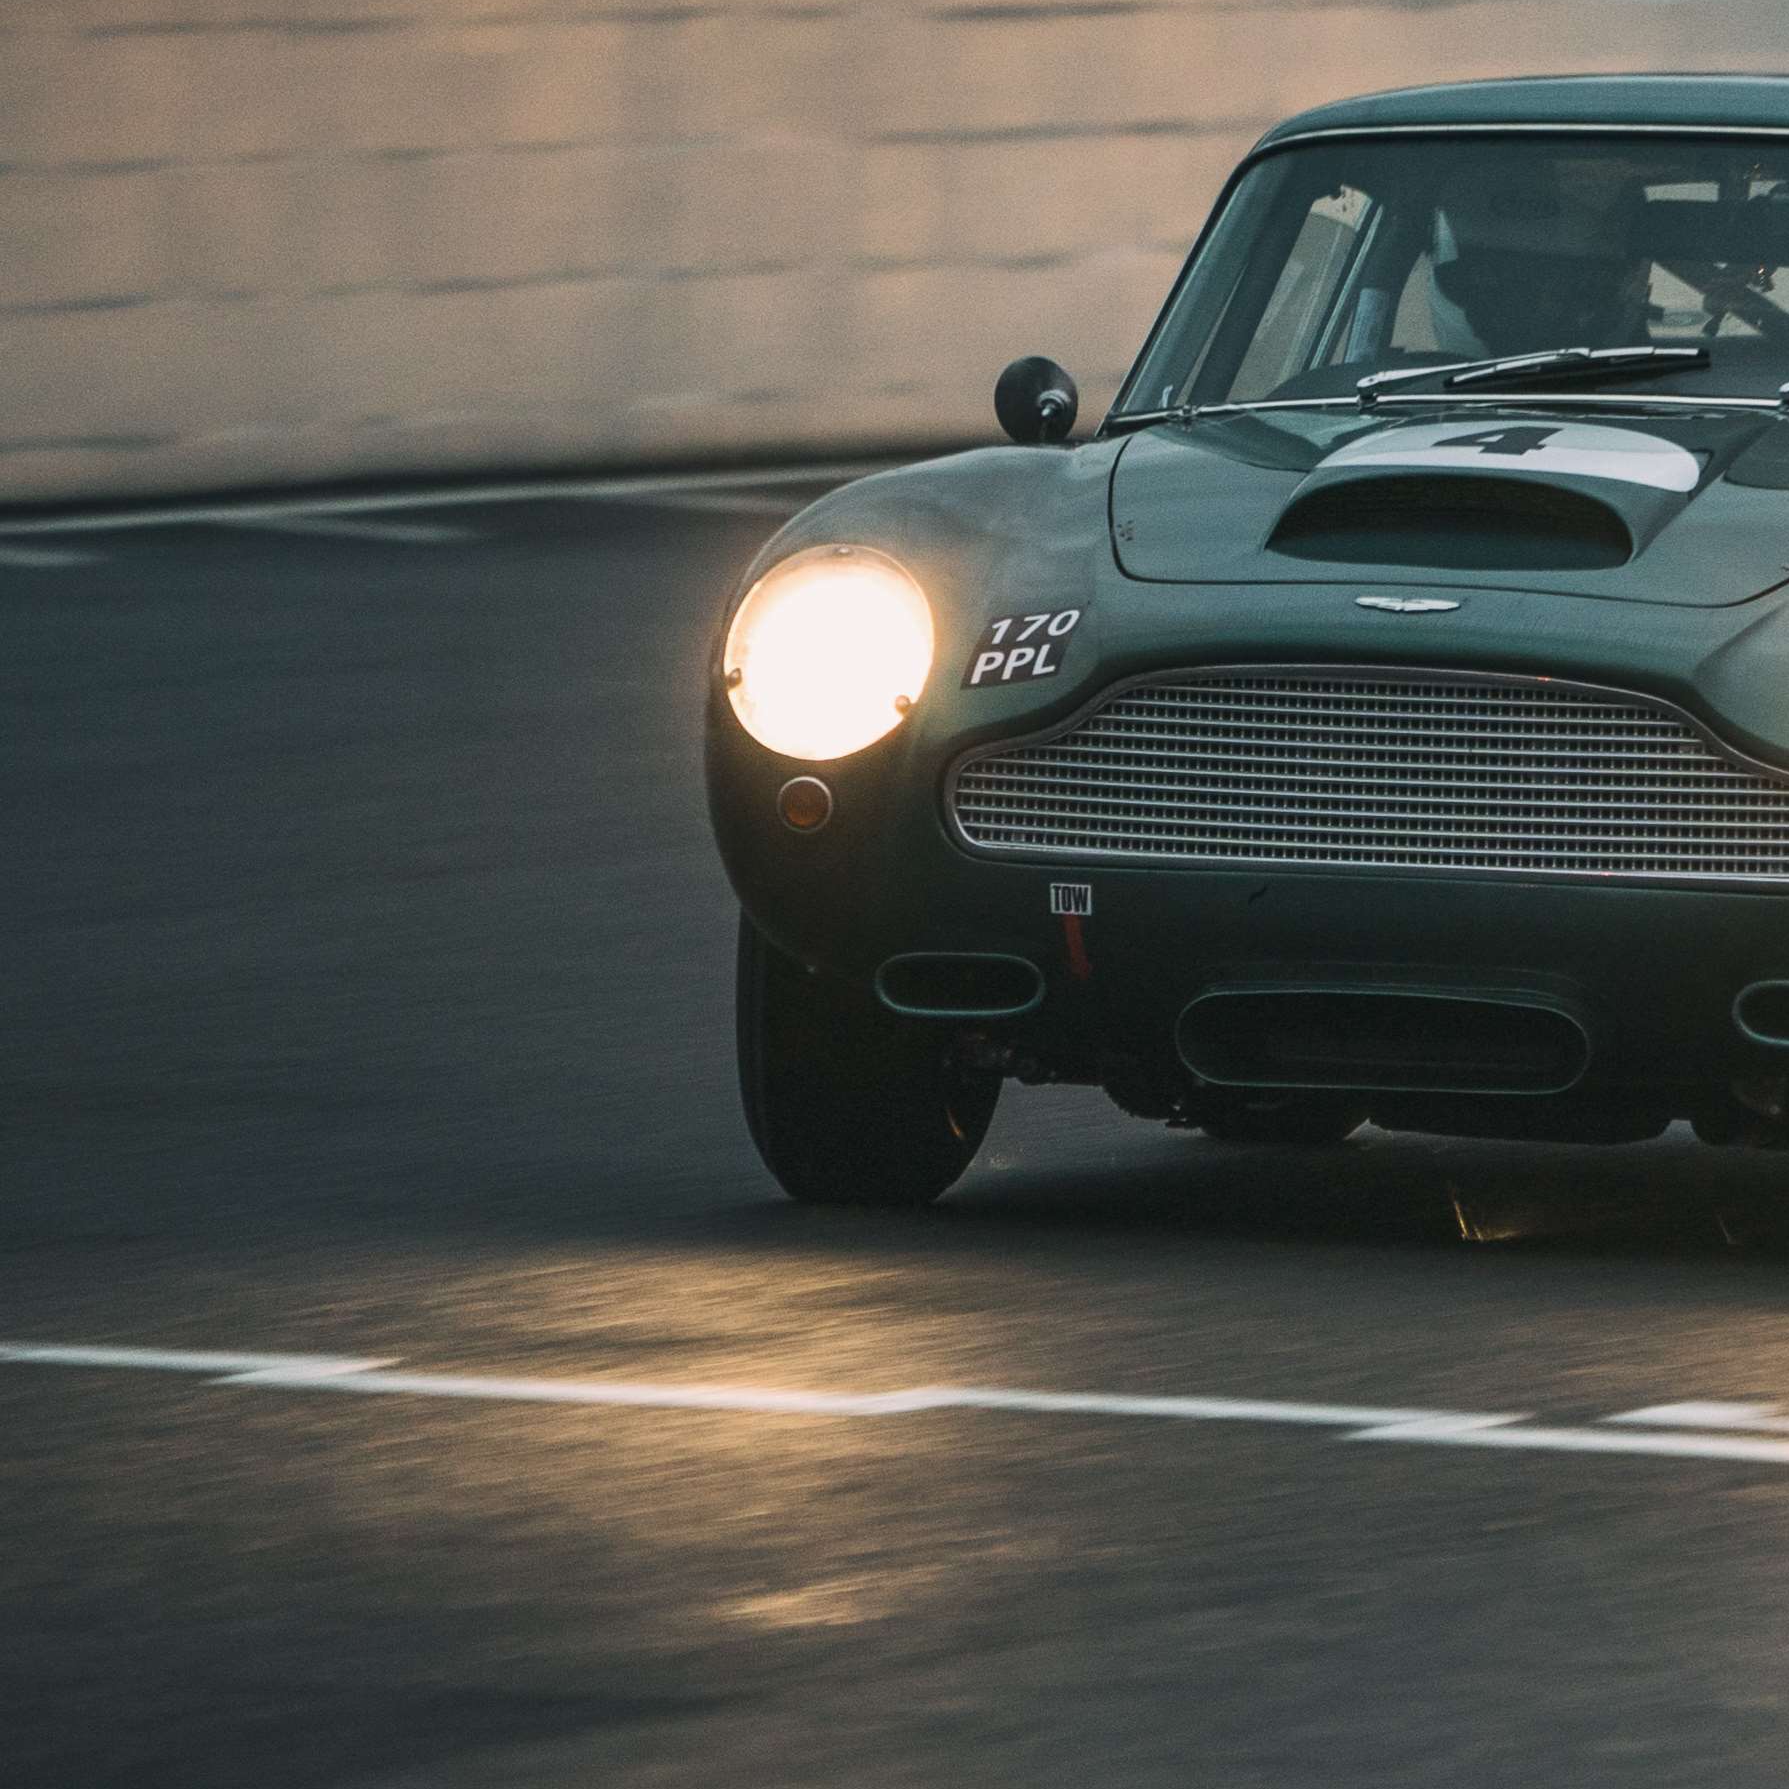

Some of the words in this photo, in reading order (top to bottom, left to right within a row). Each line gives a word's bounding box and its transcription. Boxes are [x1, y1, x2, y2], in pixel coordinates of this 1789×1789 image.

[1430, 425, 1565, 456] 4
[991, 609, 1080, 645] 170
[969, 643, 1056, 685] PPL
[1054, 885, 1089, 913] TOW
